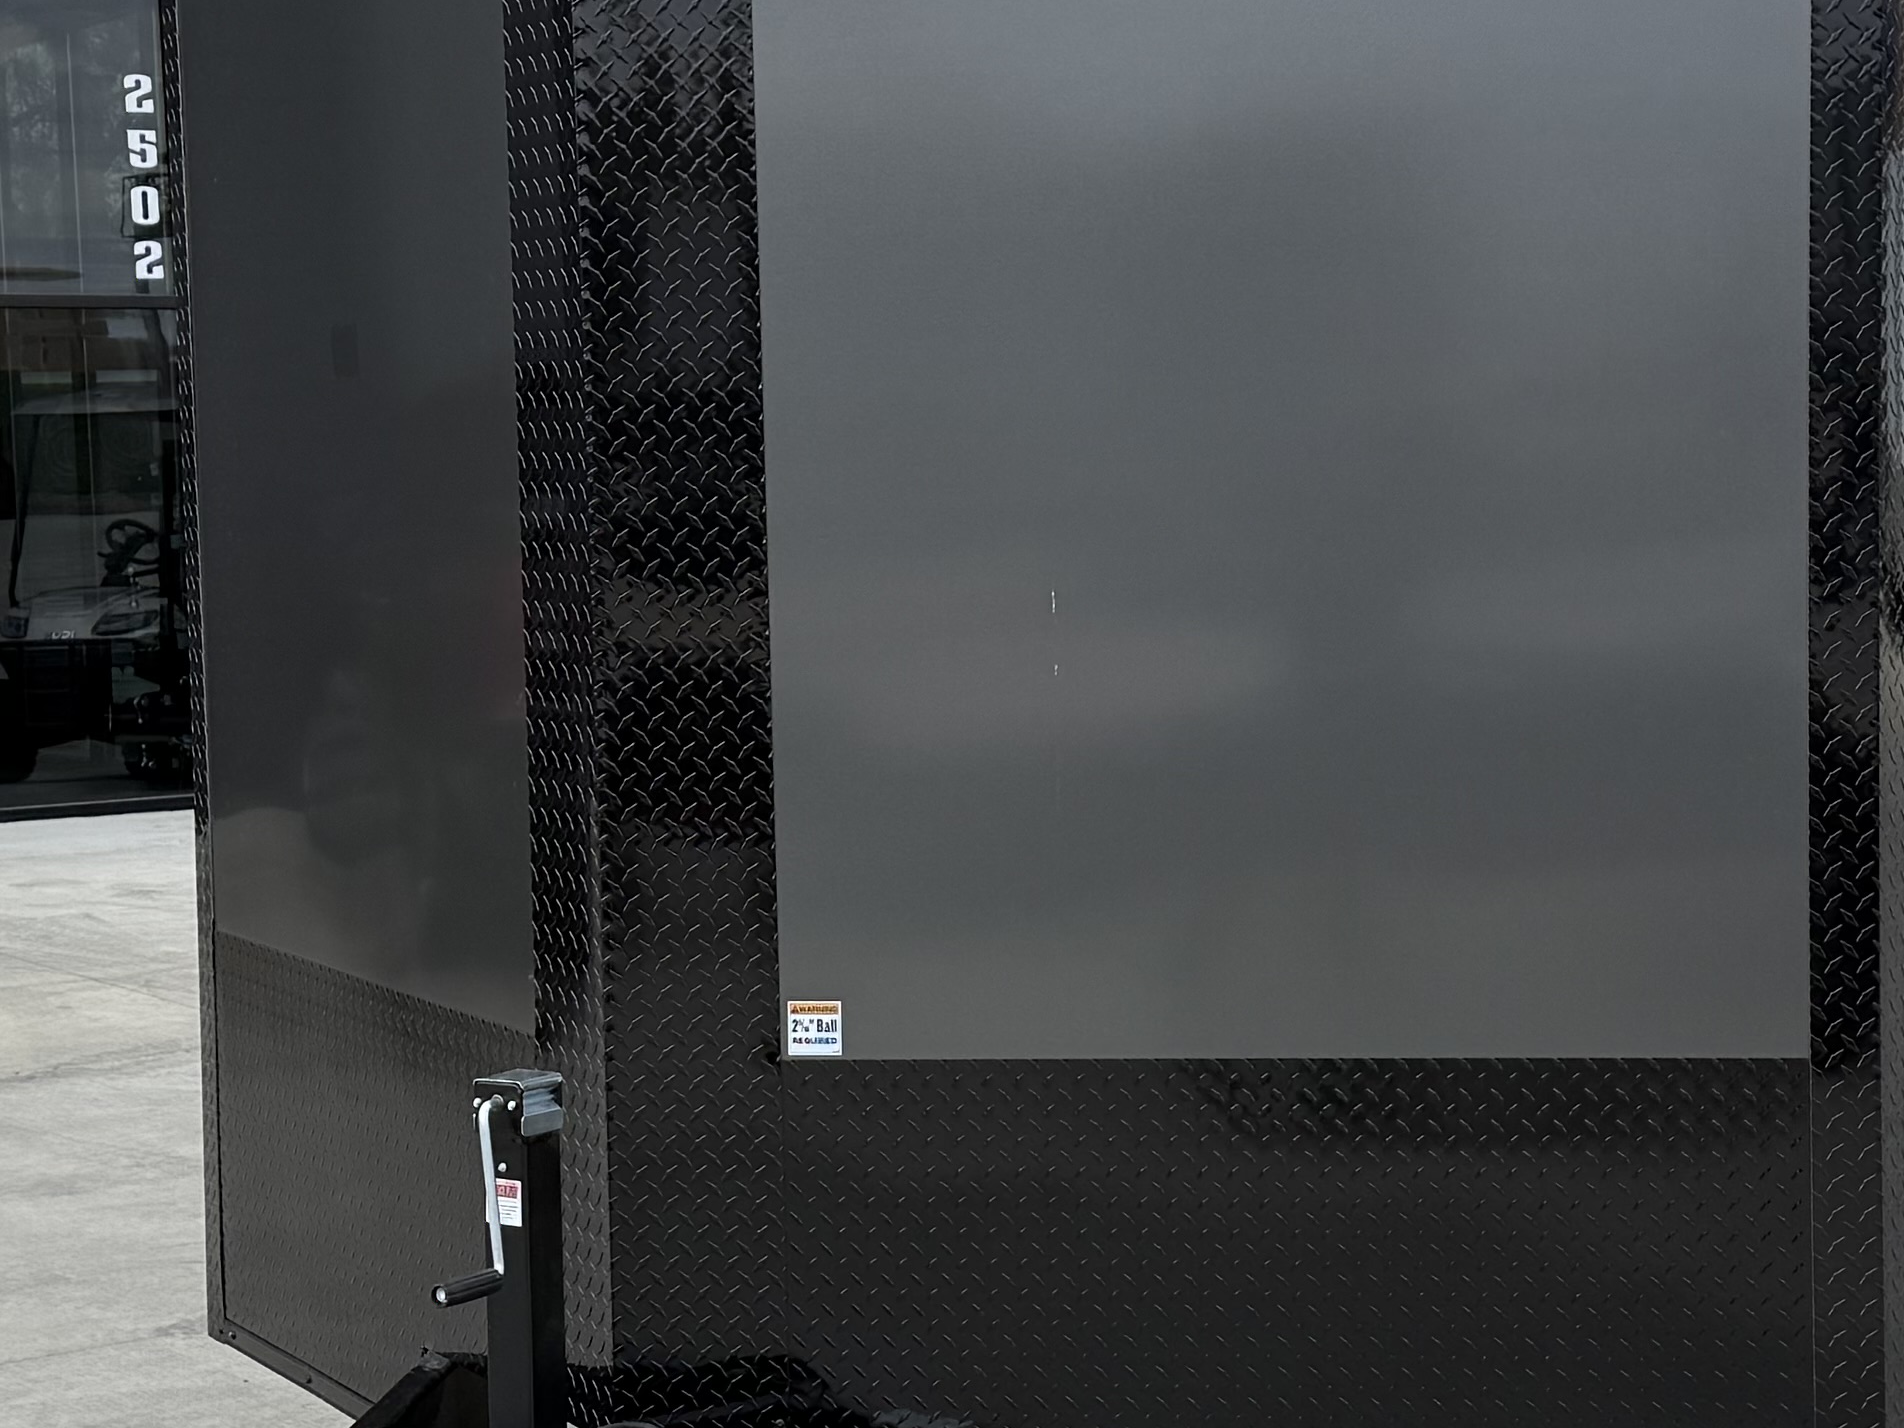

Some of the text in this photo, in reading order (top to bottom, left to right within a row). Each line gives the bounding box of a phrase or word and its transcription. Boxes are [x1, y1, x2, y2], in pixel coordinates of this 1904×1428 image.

[123, 74, 165, 280] 2502
[816, 1018, 837, 1032] Ball
[792, 1037, 838, 1045] REQUIRED
